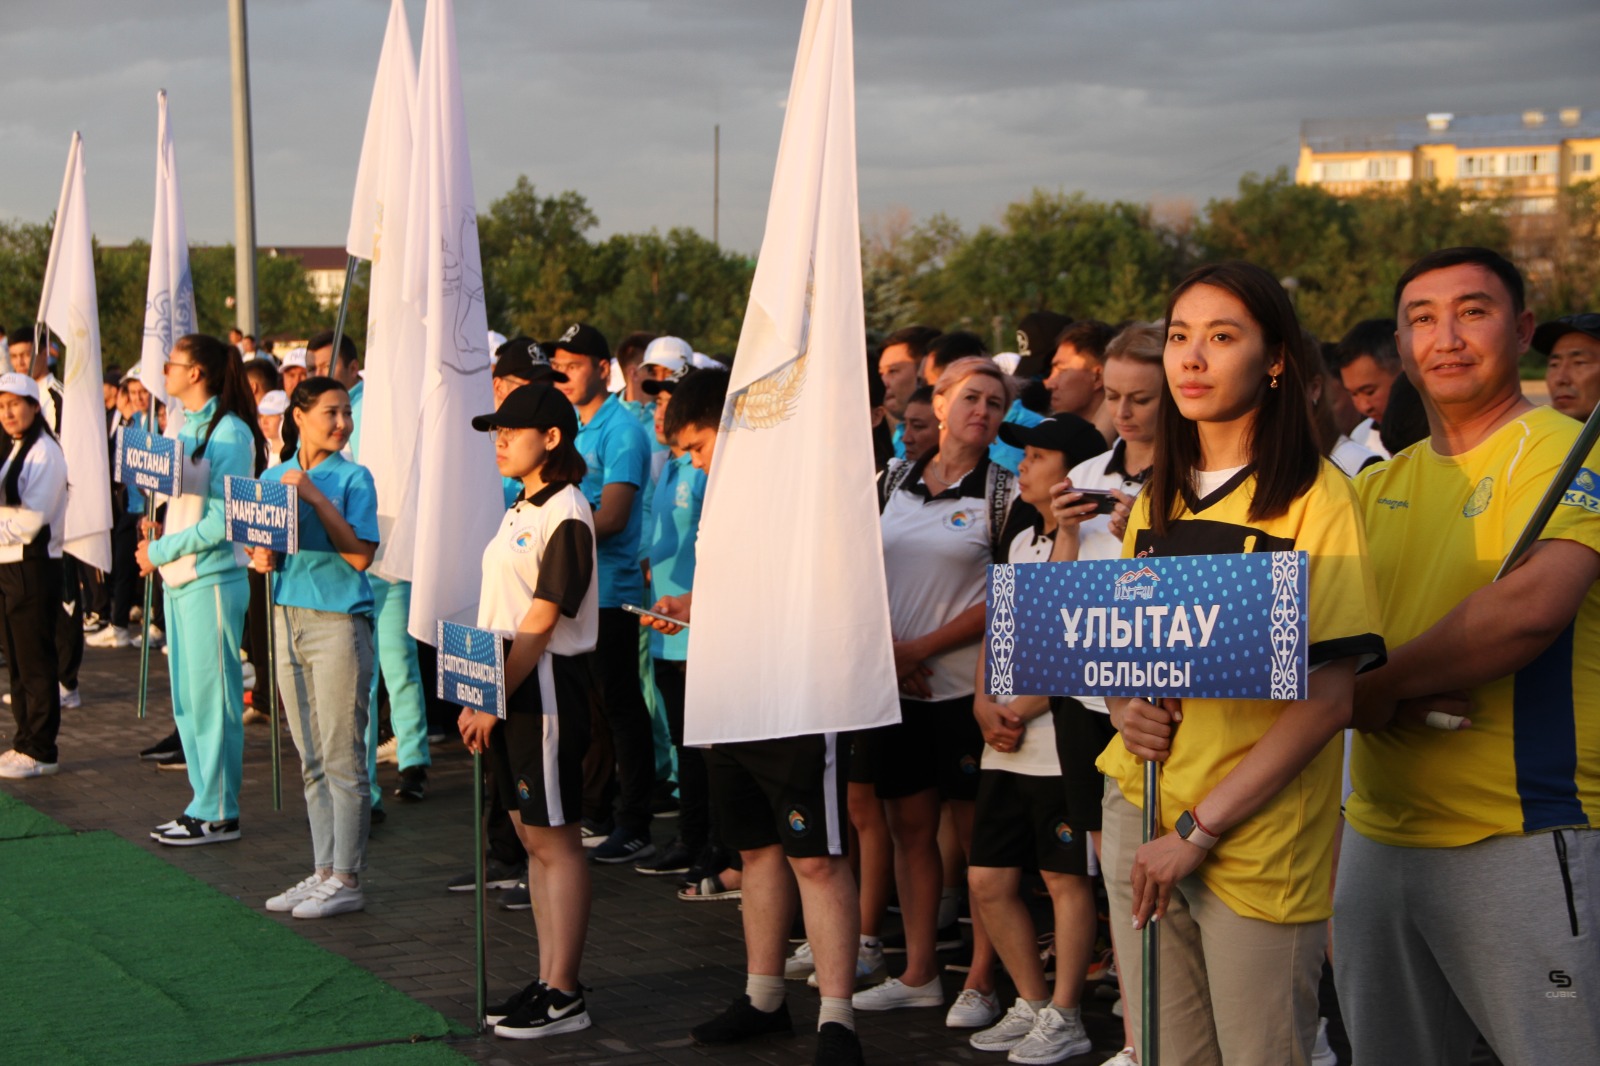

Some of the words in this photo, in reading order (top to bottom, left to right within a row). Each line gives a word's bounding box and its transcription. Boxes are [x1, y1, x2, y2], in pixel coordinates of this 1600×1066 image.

[135, 472, 160, 490] ОБЛЫСЫ
[231, 499, 287, 528] МАҢҒЫСТАУ
[247, 527, 273, 545] ОБЛЫСЫ
[1060, 604, 1221, 648] ҰЛЫТАУ
[1084, 660, 1191, 687] ОБЛЫСЫ
[456, 682, 483, 707] ОБЛЫСЫ
